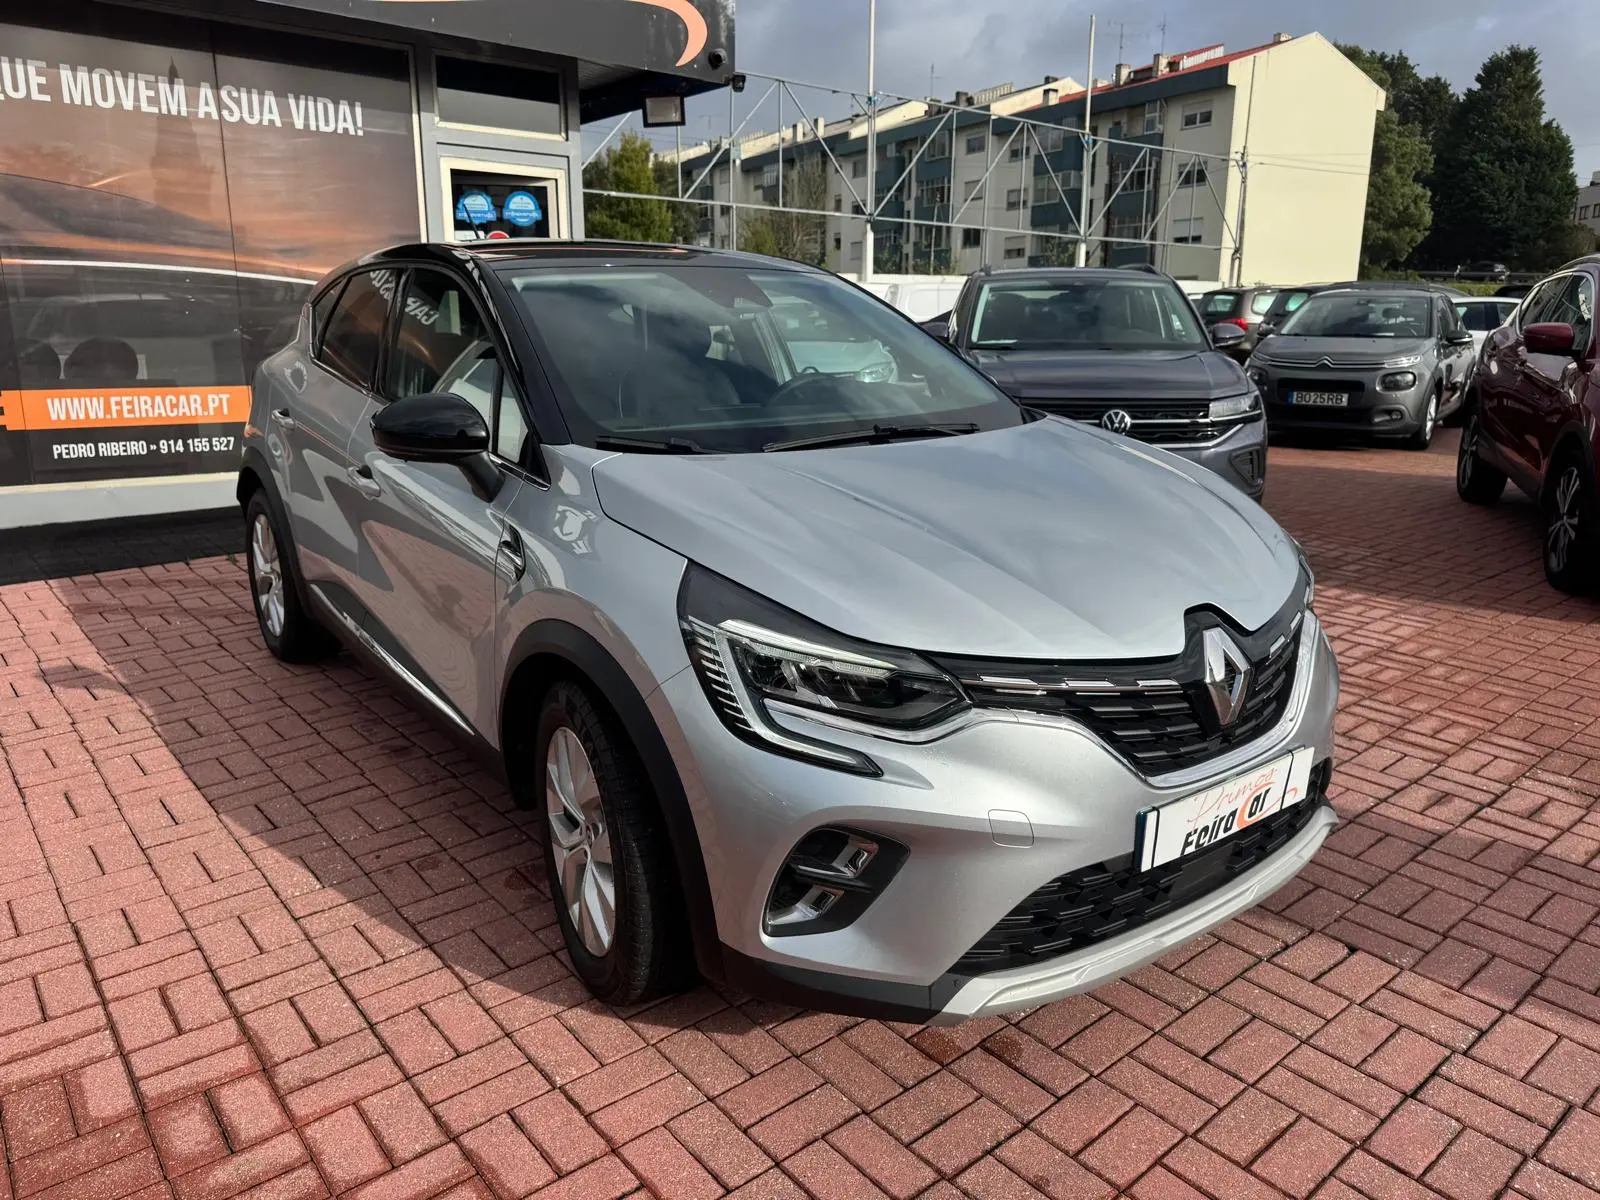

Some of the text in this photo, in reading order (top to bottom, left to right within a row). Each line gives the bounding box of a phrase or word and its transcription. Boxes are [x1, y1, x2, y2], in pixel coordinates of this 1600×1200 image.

[0, 56, 52, 102] UE
[59, 63, 188, 117] MOVEM
[287, 93, 364, 136] VIDA!
[46, 393, 230, 421] WWW.FEIRACAR.PT
[52, 442, 96, 460] PEDRO
[97, 440, 148, 458] RIBEIRO
[159, 438, 185, 455] 914
[186, 436, 211, 453] 155
[212, 435, 236, 452] 527
